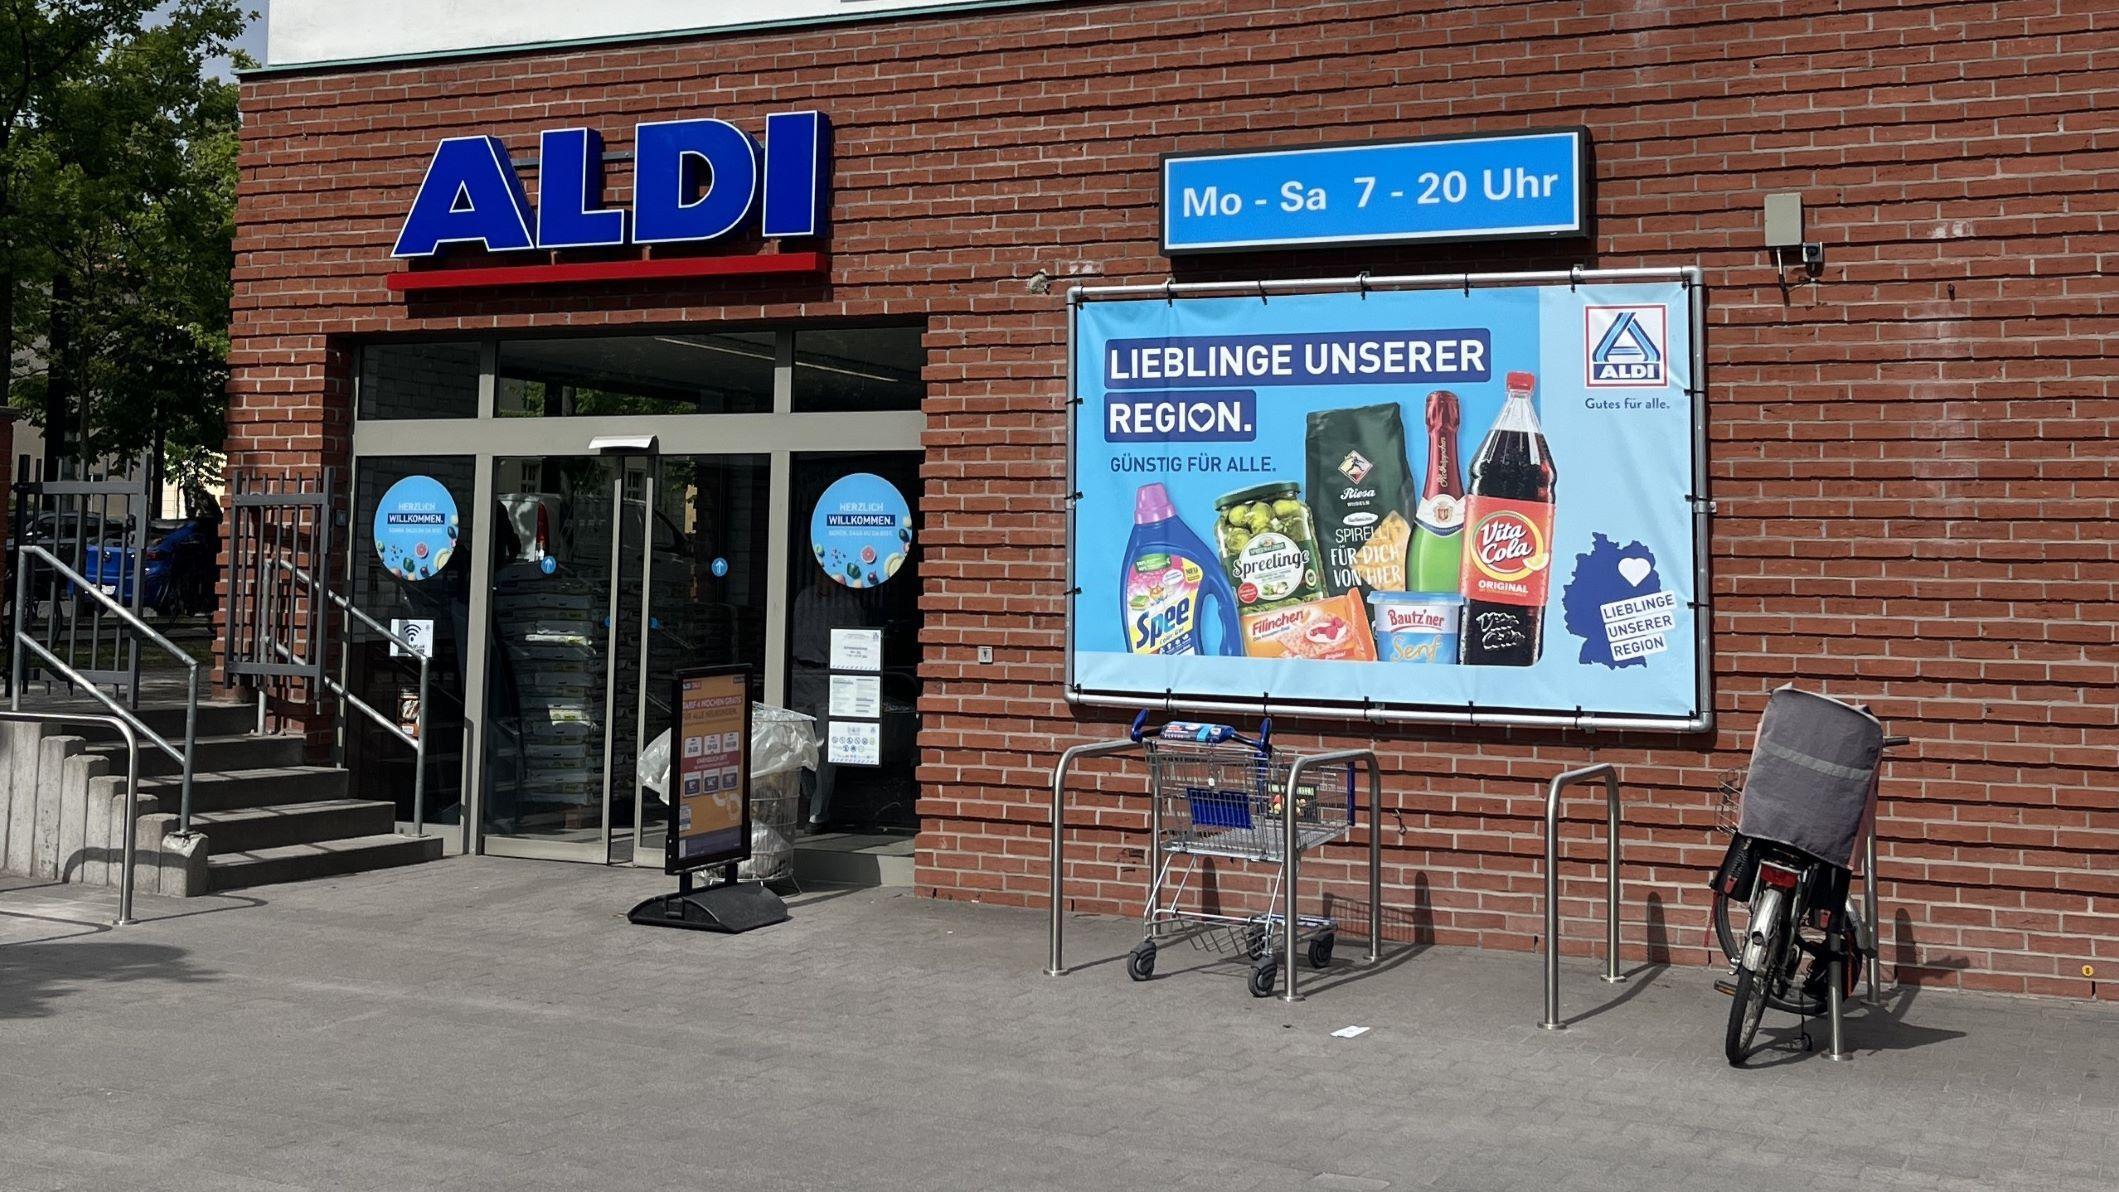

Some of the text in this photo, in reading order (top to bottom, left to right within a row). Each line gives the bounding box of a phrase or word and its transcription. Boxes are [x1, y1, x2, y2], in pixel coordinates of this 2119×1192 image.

[390, 110, 820, 258] ALDI
[1183, 186, 1243, 218] Mo
[1280, 180, 1326, 213] Sa
[1354, 177, 1376, 208] 7
[1417, 170, 1468, 205] 20
[1482, 167, 1558, 201] Uhr
[1110, 339, 1486, 380] LIEBLINGE UNSERER
[1599, 364, 1655, 379] ALDI
[1585, 397, 1670, 409] Gutes für alle.
[1109, 401, 1252, 434] REGION.
[1110, 453, 1277, 473] GÜNSTIG FÜR ALLE.
[1340, 487, 1376, 500] Riesa
[398, 502, 436, 511] HERZLICH
[840, 502, 884, 512] HERZLICH
[389, 514, 443, 523] WILLKOMMEN.
[829, 515, 894, 525] WILLKOMMEN.
[1480, 519, 1526, 546] Vita
[1330, 544, 1399, 566] FÜR DICH
[1482, 537, 1532, 564] Cola
[1233, 550, 1309, 579] Spreelinge
[1334, 565, 1401, 587] VON HIER
[1478, 580, 1528, 594] ORIGINAL
[1603, 594, 1674, 619] LIEBLINGE
[1136, 598, 1190, 649] Spee
[1252, 610, 1304, 635] Filinchen
[1388, 609, 1444, 627] Bautz'ner
[1608, 615, 1673, 637] UNSERER
[1390, 634, 1443, 664] Senf
[1613, 636, 1665, 657] REGION
